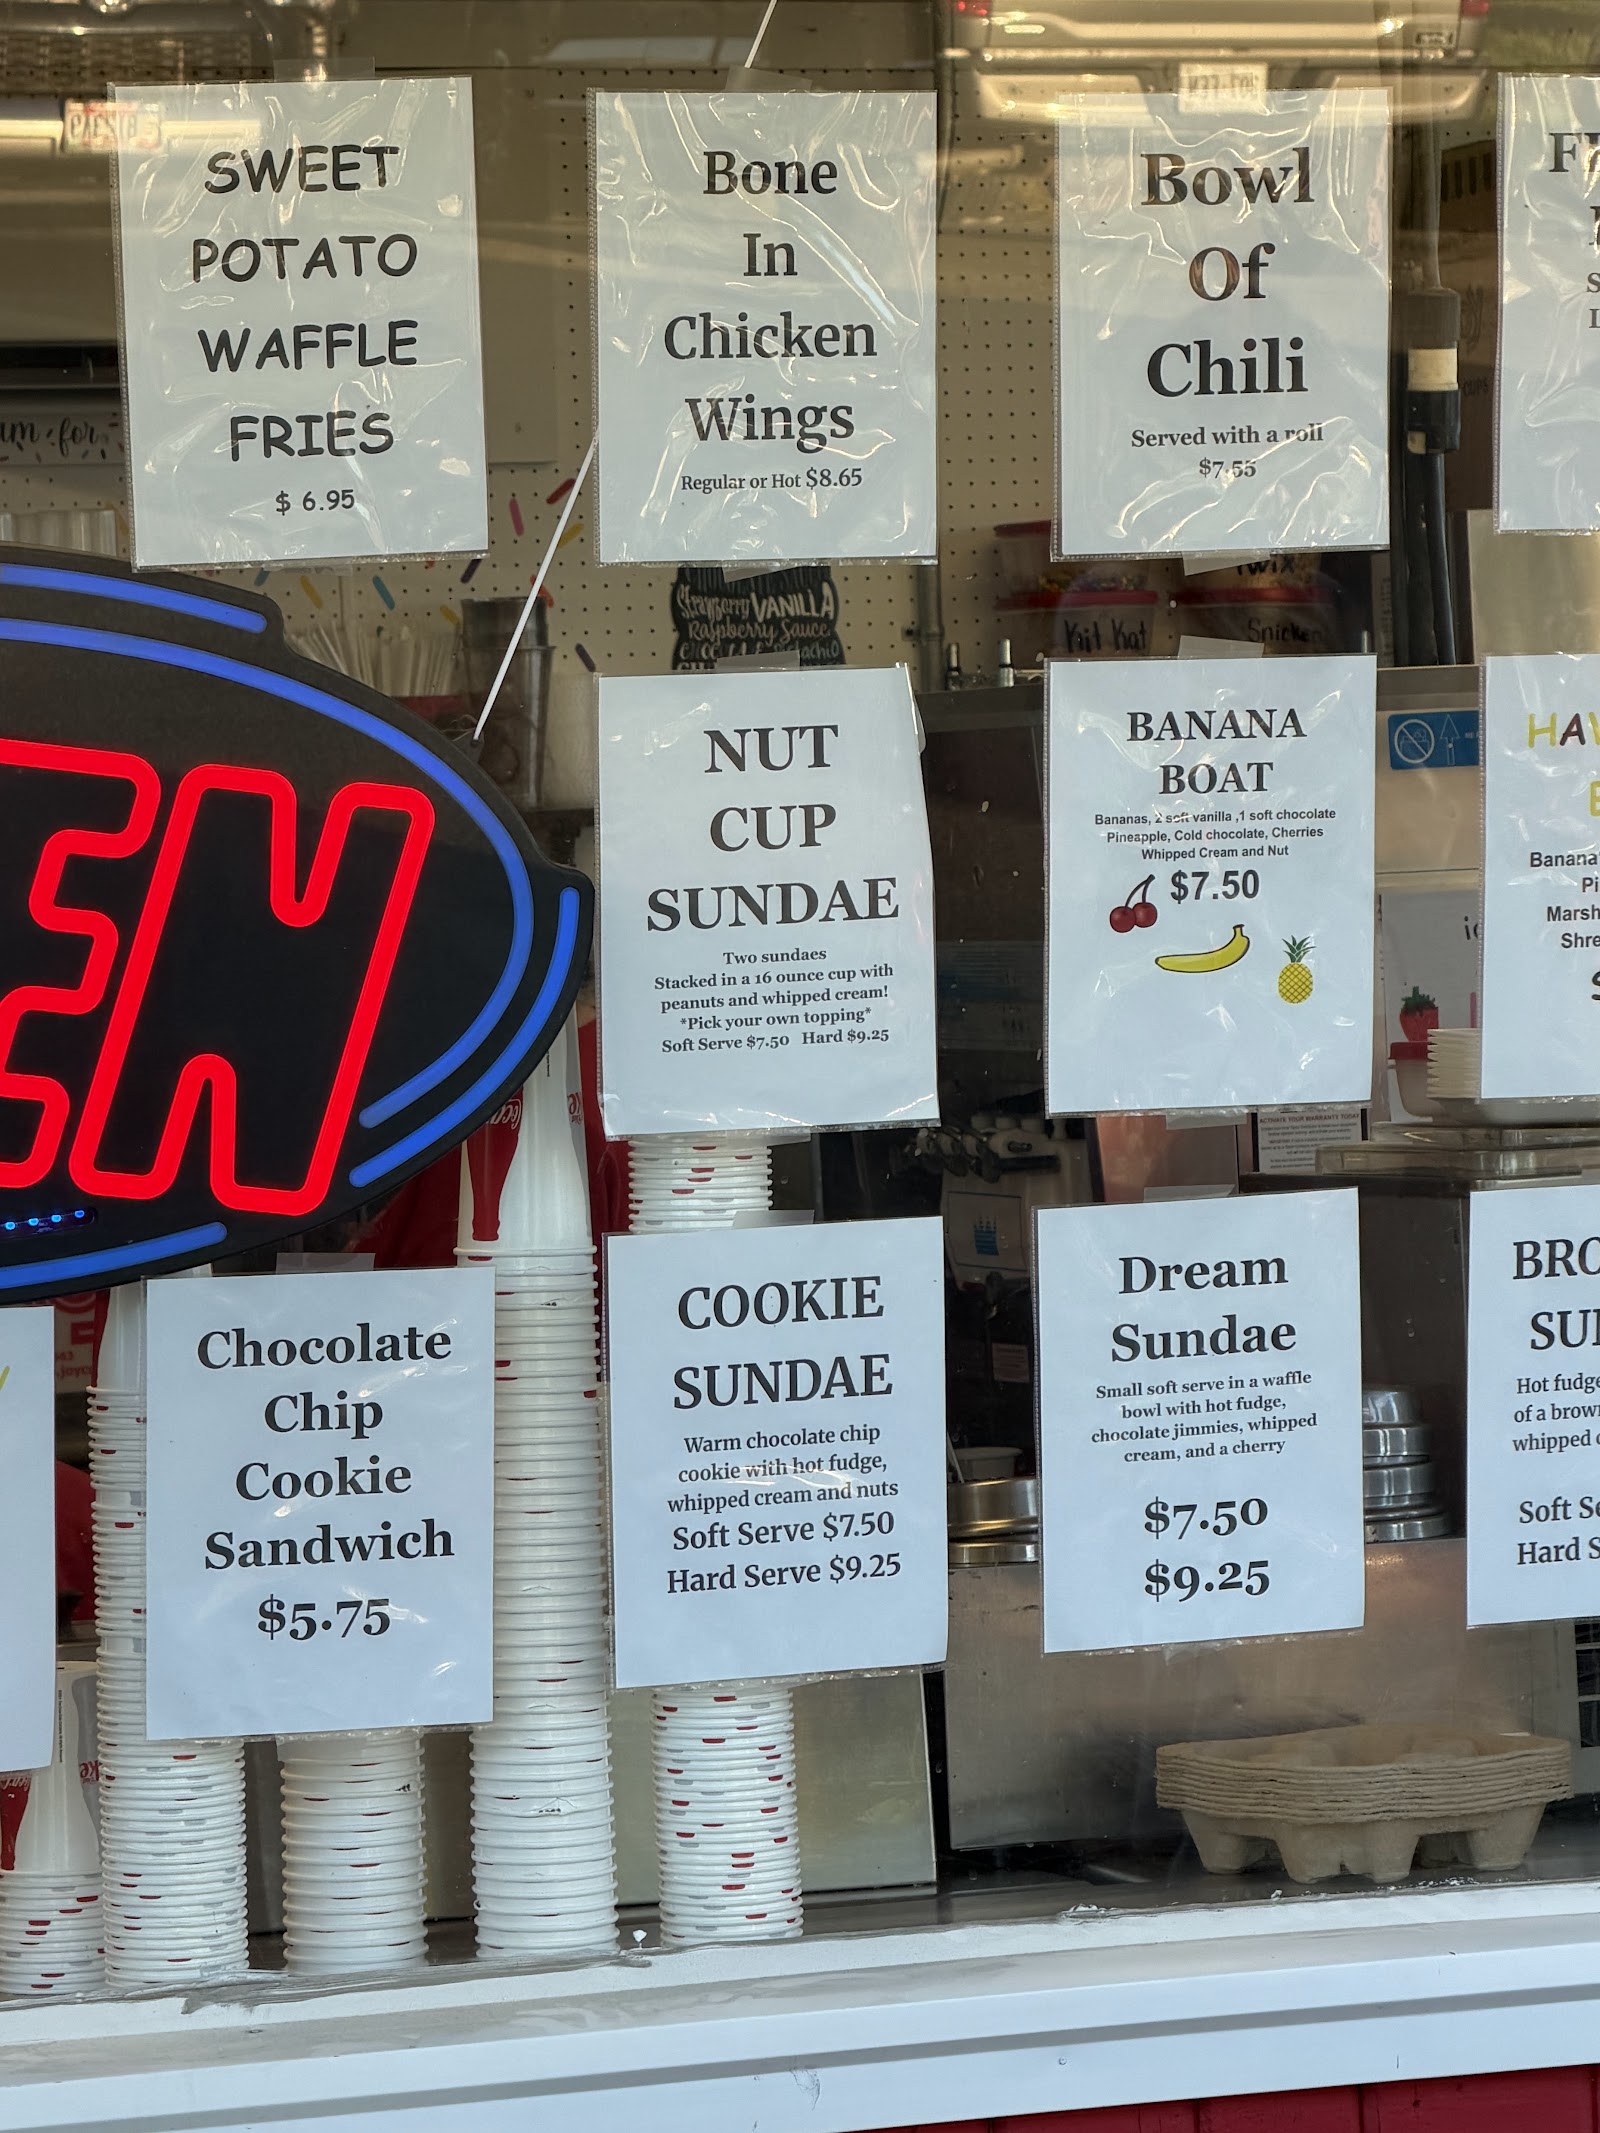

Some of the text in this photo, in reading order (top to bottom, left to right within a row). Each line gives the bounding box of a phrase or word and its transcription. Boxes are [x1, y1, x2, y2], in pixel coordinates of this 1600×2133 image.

[205, 144, 400, 194] SWEET
[703, 147, 837, 194] Bone
[1141, 147, 1314, 206] Bowl
[193, 234, 417, 283] POTATO
[743, 233, 798, 276] In
[1189, 242, 1275, 301] Of
[198, 320, 418, 372] WAFFLE
[665, 311, 877, 360] Chicken
[1147, 337, 1308, 397] Chili
[230, 410, 394, 462] FRIES
[685, 394, 854, 454] Wings
[1132, 423, 1324, 447] Served with a roll
[681, 467, 862, 494] Regular or Hot $8.65
[1200, 457, 1256, 478] $7.55
[276, 489, 354, 516] $ 6.95
[751, 580, 835, 623] VANILLA
[1064, 618, 1146, 653] Kit Kat
[1127, 708, 1307, 741] BANANA
[704, 725, 838, 773] NUT
[1159, 762, 1273, 794] BOAT
[710, 804, 836, 851] CUP
[1095, 814, 1151, 825] Bananas,
[1166, 812, 1189, 823] soft
[1193, 811, 1231, 822] vanilla
[1250, 810, 1273, 820] soft
[1276, 808, 1336, 820] chocolate
[1108, 827, 1323, 844] Pineapple, Cold chocolate, Cherries
[1142, 845, 1288, 861] Whipped Cream and Nut
[648, 878, 899, 931] SUNDAE
[1171, 870, 1259, 904] $7.50
[723, 948, 826, 964] Two sundaes
[655, 964, 893, 989] Stacked in a 16 ounce cup with
[661, 985, 887, 1014] peanuts and whipped cream!
[662, 1029, 889, 1052] Soft Serve $7.50 Hard $9.25
[725, 1017, 762, 1031] your
[766, 1015, 799, 1025] own
[1119, 1257, 1288, 1294] Dream
[678, 1276, 884, 1329] COOKIE
[198, 1323, 451, 1369] Chocolate
[1112, 1314, 1296, 1362] Sundae
[1531, 1309, 1600, 1350] SU
[674, 1354, 893, 1409] SUNDAE
[1097, 1371, 1311, 1398] Small soft serve in a waffle
[1517, 1377, 1549, 1394] Hot
[265, 1390, 383, 1439] Chip
[1122, 1395, 1286, 1418] bowl with hot fudge,
[1514, 1405, 1533, 1422] of
[1536, 1409, 1546, 1421] a
[684, 1424, 880, 1453] Warm chocolate chip
[1092, 1413, 1317, 1443] chocolate jimmies, whipped
[1513, 1429, 1600, 1453] whipped
[679, 1453, 886, 1482] cookie with hot fudge,
[1124, 1440, 1285, 1462] cream, and a cherry
[236, 1455, 411, 1500] Cookie
[667, 1481, 898, 1514] whipped cream and nuts
[1520, 1496, 1572, 1523] Soft
[674, 1511, 894, 1550] Soft Serve $7.50
[1145, 1496, 1268, 1539] $7.50
[205, 1518, 455, 1569] Sandwich
[1517, 1537, 1581, 1565] Hard
[667, 1553, 900, 1593] Hard Serve $9.25
[1145, 1559, 1269, 1602] $9.25
[258, 1594, 390, 1640] $5.75
